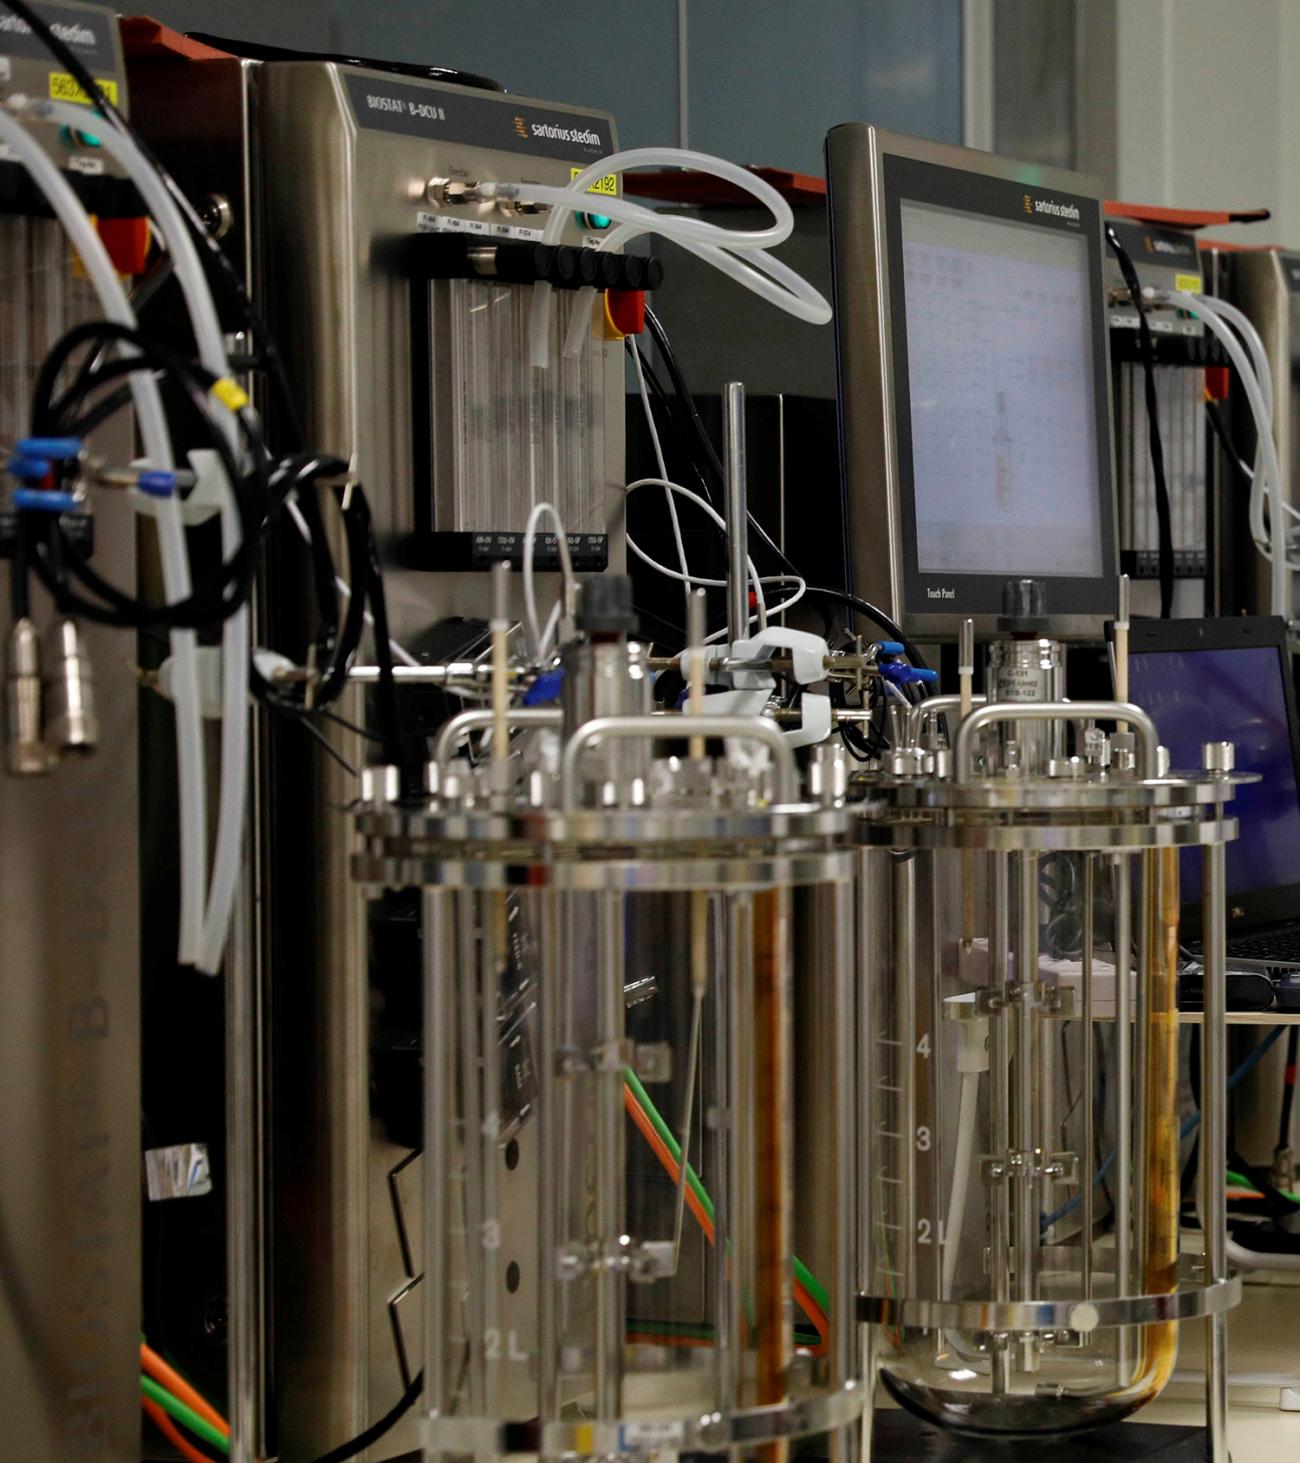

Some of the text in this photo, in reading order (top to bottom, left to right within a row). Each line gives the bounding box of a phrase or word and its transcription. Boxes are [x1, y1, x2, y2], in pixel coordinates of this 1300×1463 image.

[531, 123, 601, 147] sartorius stedim
[1034, 200, 1080, 220] sartorius stedim
[927, 587, 955, 599] Touch Panel
[916, 1033, 931, 1059] 4
[916, 1126, 931, 1151] 3
[482, 1219, 500, 1250] 3
[917, 1218, 932, 1244] 2
